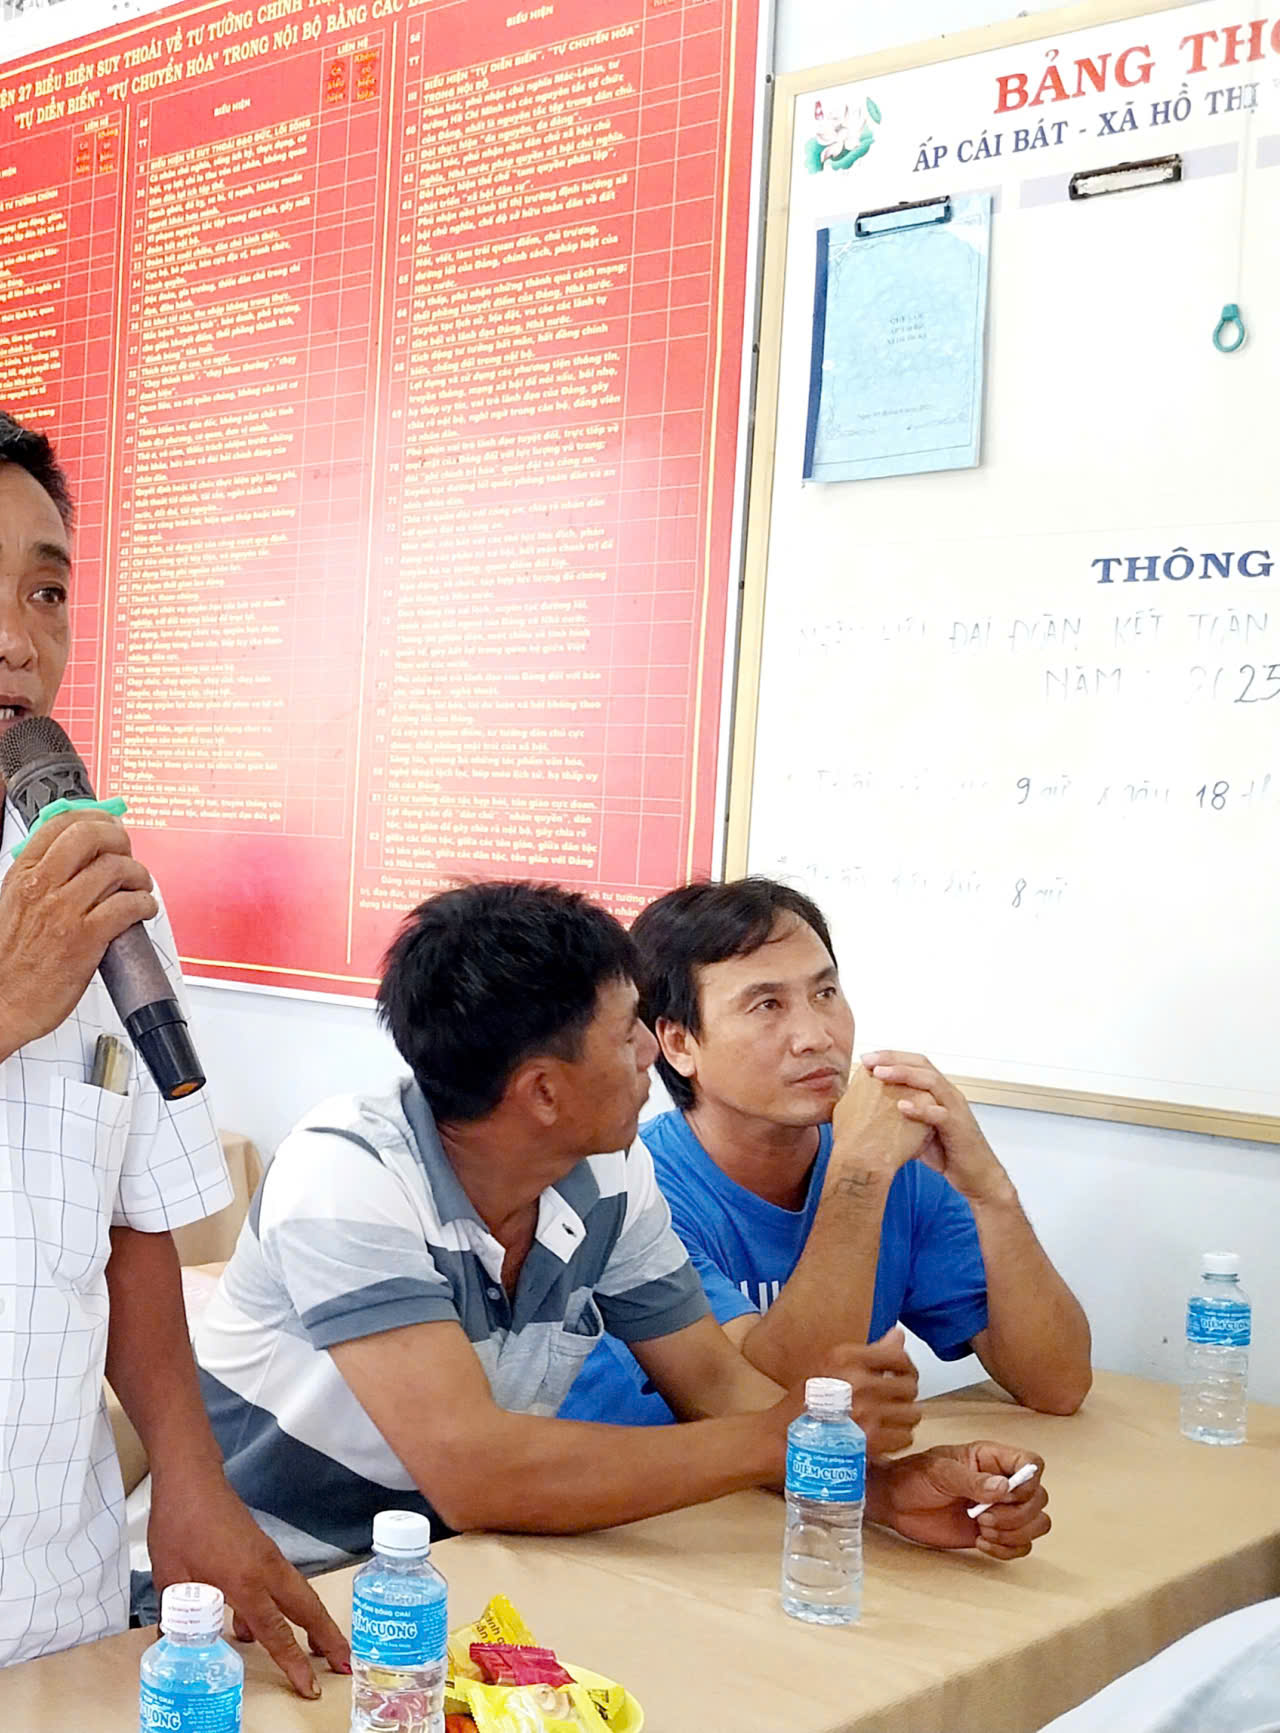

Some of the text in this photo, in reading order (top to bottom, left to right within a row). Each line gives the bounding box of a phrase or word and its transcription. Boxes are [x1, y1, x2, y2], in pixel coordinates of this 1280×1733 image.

[17, 83, 33, 103] 27
[34, 67, 62, 98] BIỂU
[63, 62, 94, 88] HIỆN
[96, 54, 121, 78] SUY
[123, 37, 163, 69] THOÁI
[164, 25, 183, 54] VỀ
[185, 23, 205, 48] TƯ
[206, 9, 253, 41] TƯỞNG
[130, 55, 183, 94] CHUYỂN
[222, 34, 269, 66] TRONG
[272, 23, 299, 51] NỘI
[301, 13, 322, 41] BỘ
[325, 2, 368, 34] BẰNG
[994, 45, 1156, 114] BẢNG
[913, 136, 948, 172] ẤP
[956, 129, 1002, 162] CÁI
[1013, 118, 1069, 153] BÁT
[1097, 101, 1138, 137] XÃ
[1148, 82, 1192, 127] HỒ
[1091, 546, 1274, 584] THÔNG
[1016, 776, 1031, 805] 9
[1196, 780, 1230, 811] 18
